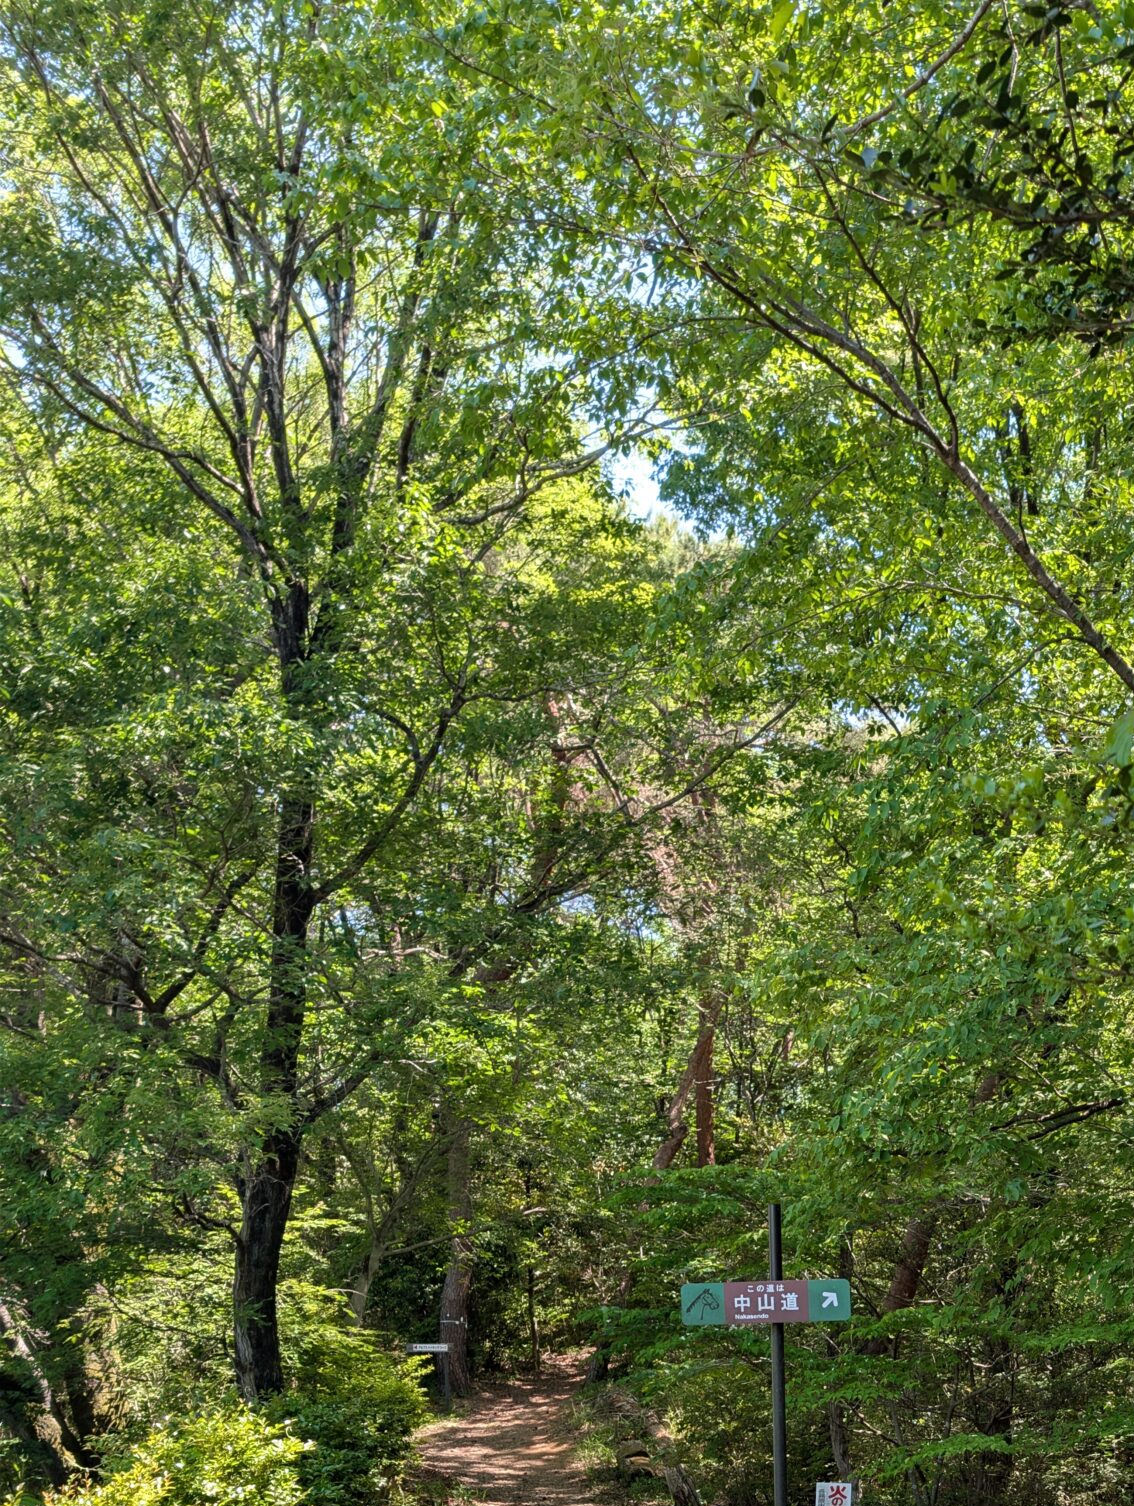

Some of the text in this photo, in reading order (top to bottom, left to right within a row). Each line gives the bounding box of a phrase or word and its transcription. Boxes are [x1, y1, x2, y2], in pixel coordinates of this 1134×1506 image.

[747, 1284, 784, 1293] この道は
[734, 1292, 800, 1312] 中山道
